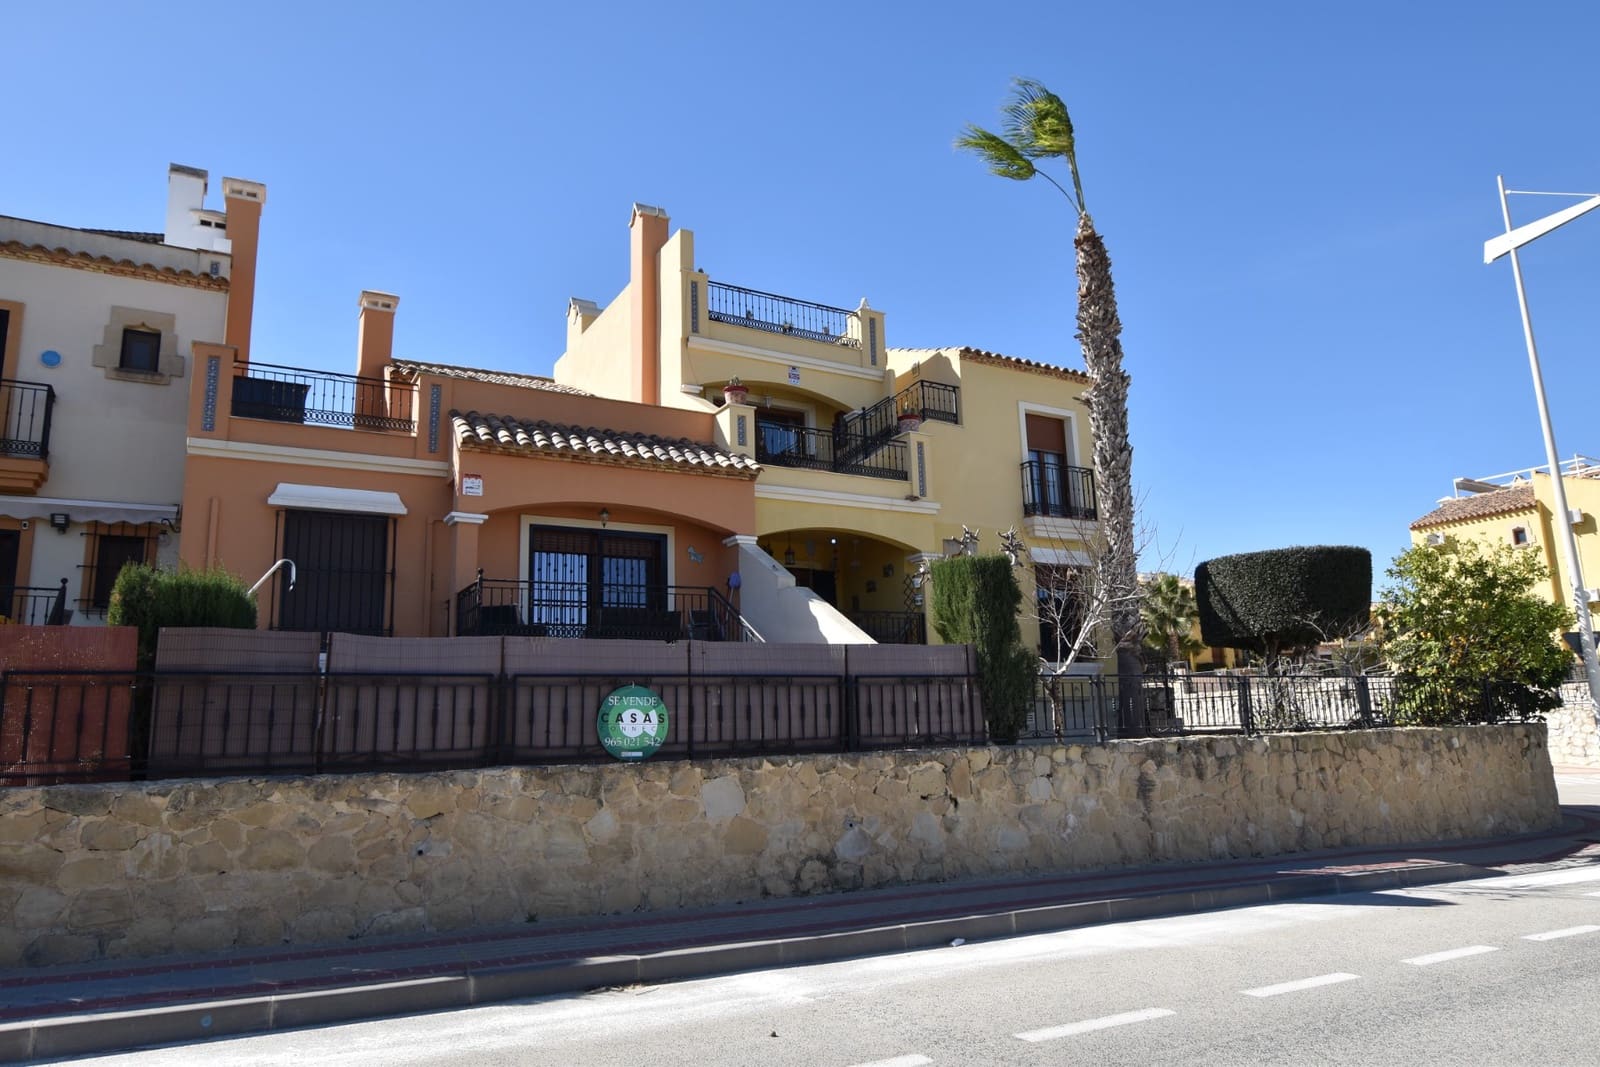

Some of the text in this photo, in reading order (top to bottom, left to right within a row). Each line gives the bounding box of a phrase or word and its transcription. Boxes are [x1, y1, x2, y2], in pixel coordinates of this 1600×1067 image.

[608, 695, 658, 706] SE VENDE
[601, 712, 665, 723] CASAS
[604, 737, 662, 747] 965 021 542
